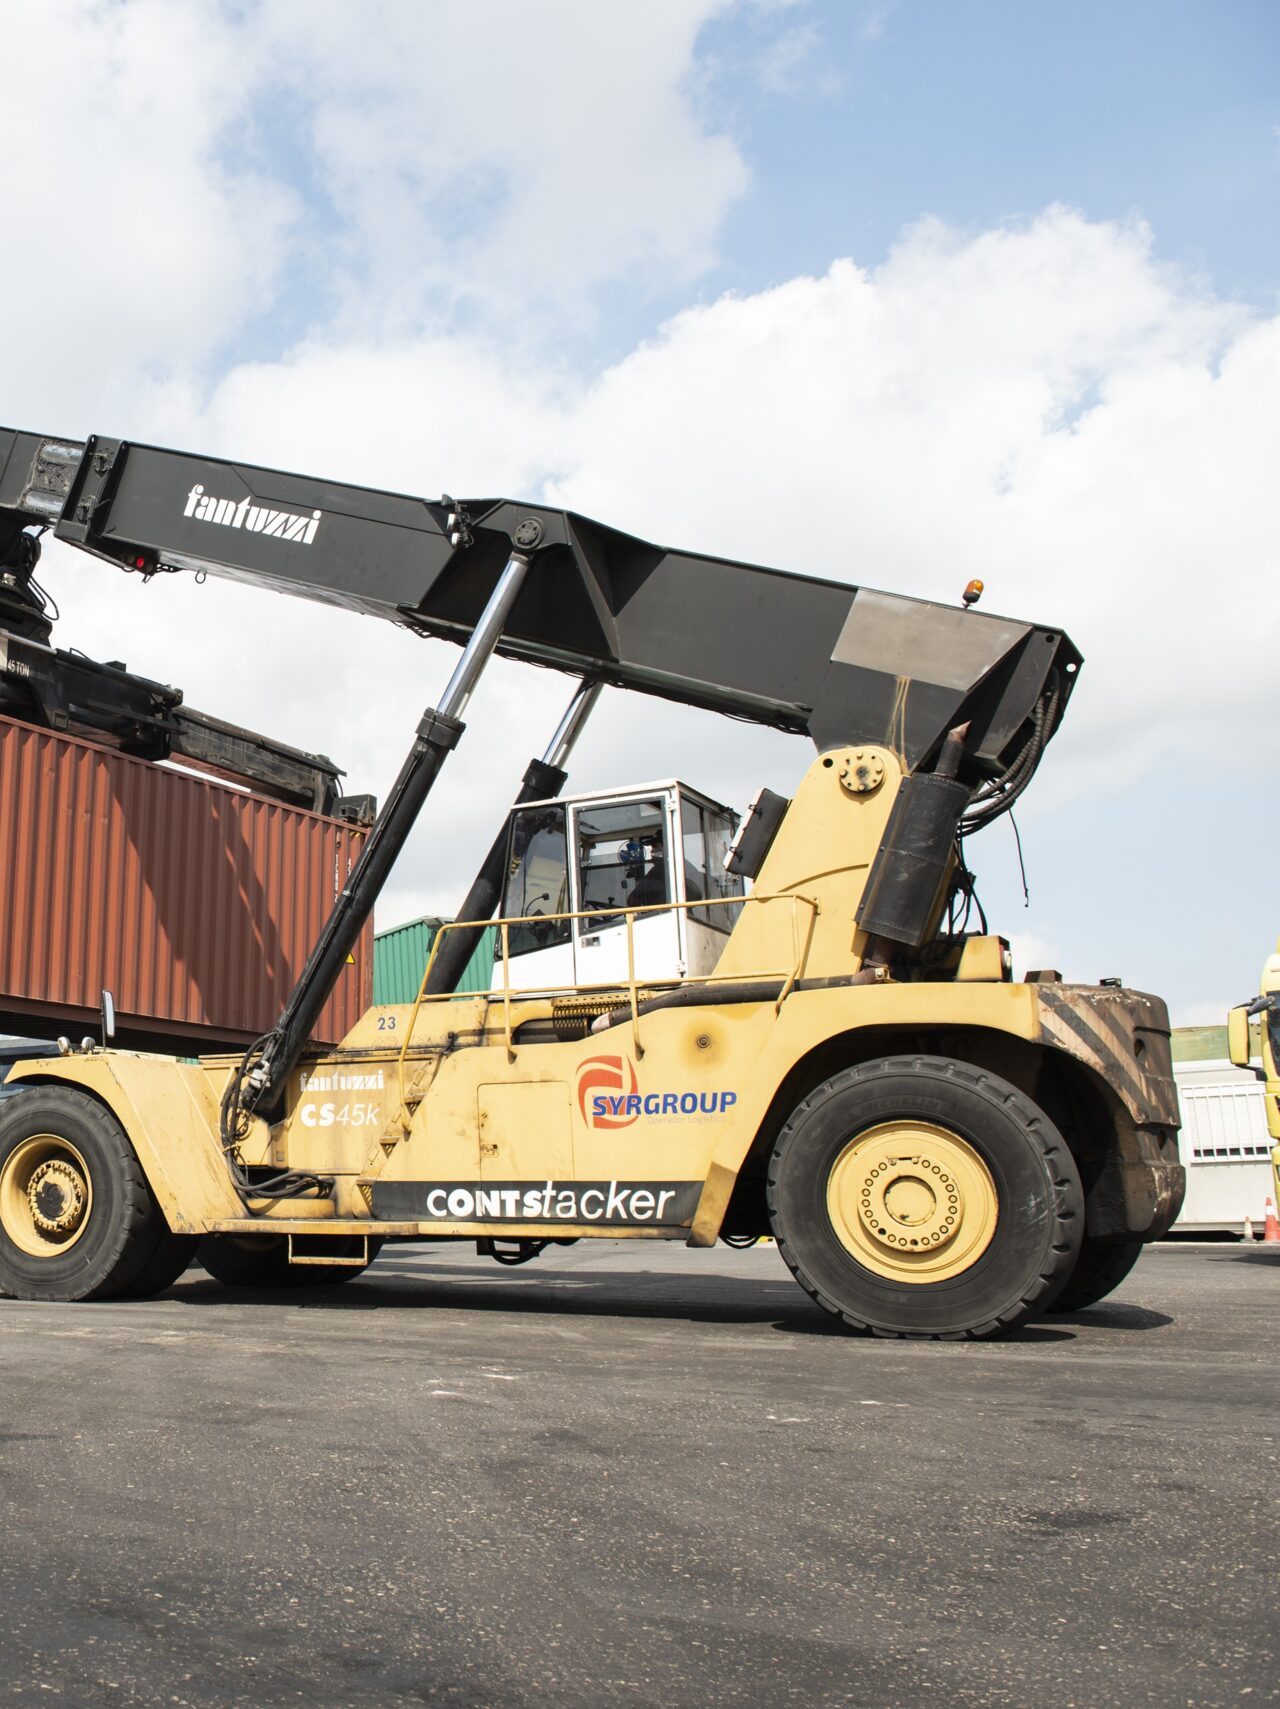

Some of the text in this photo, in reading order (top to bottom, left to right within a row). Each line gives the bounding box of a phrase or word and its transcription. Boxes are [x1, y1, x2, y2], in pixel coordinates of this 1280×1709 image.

[183, 483, 322, 545] fantuzzi
[7, 659, 15, 673] 45
[16, 661, 30, 678] TON
[377, 1016, 396, 1031] 23
[299, 1069, 384, 1093] fantuzzi
[592, 1091, 738, 1117] SYRGROUP
